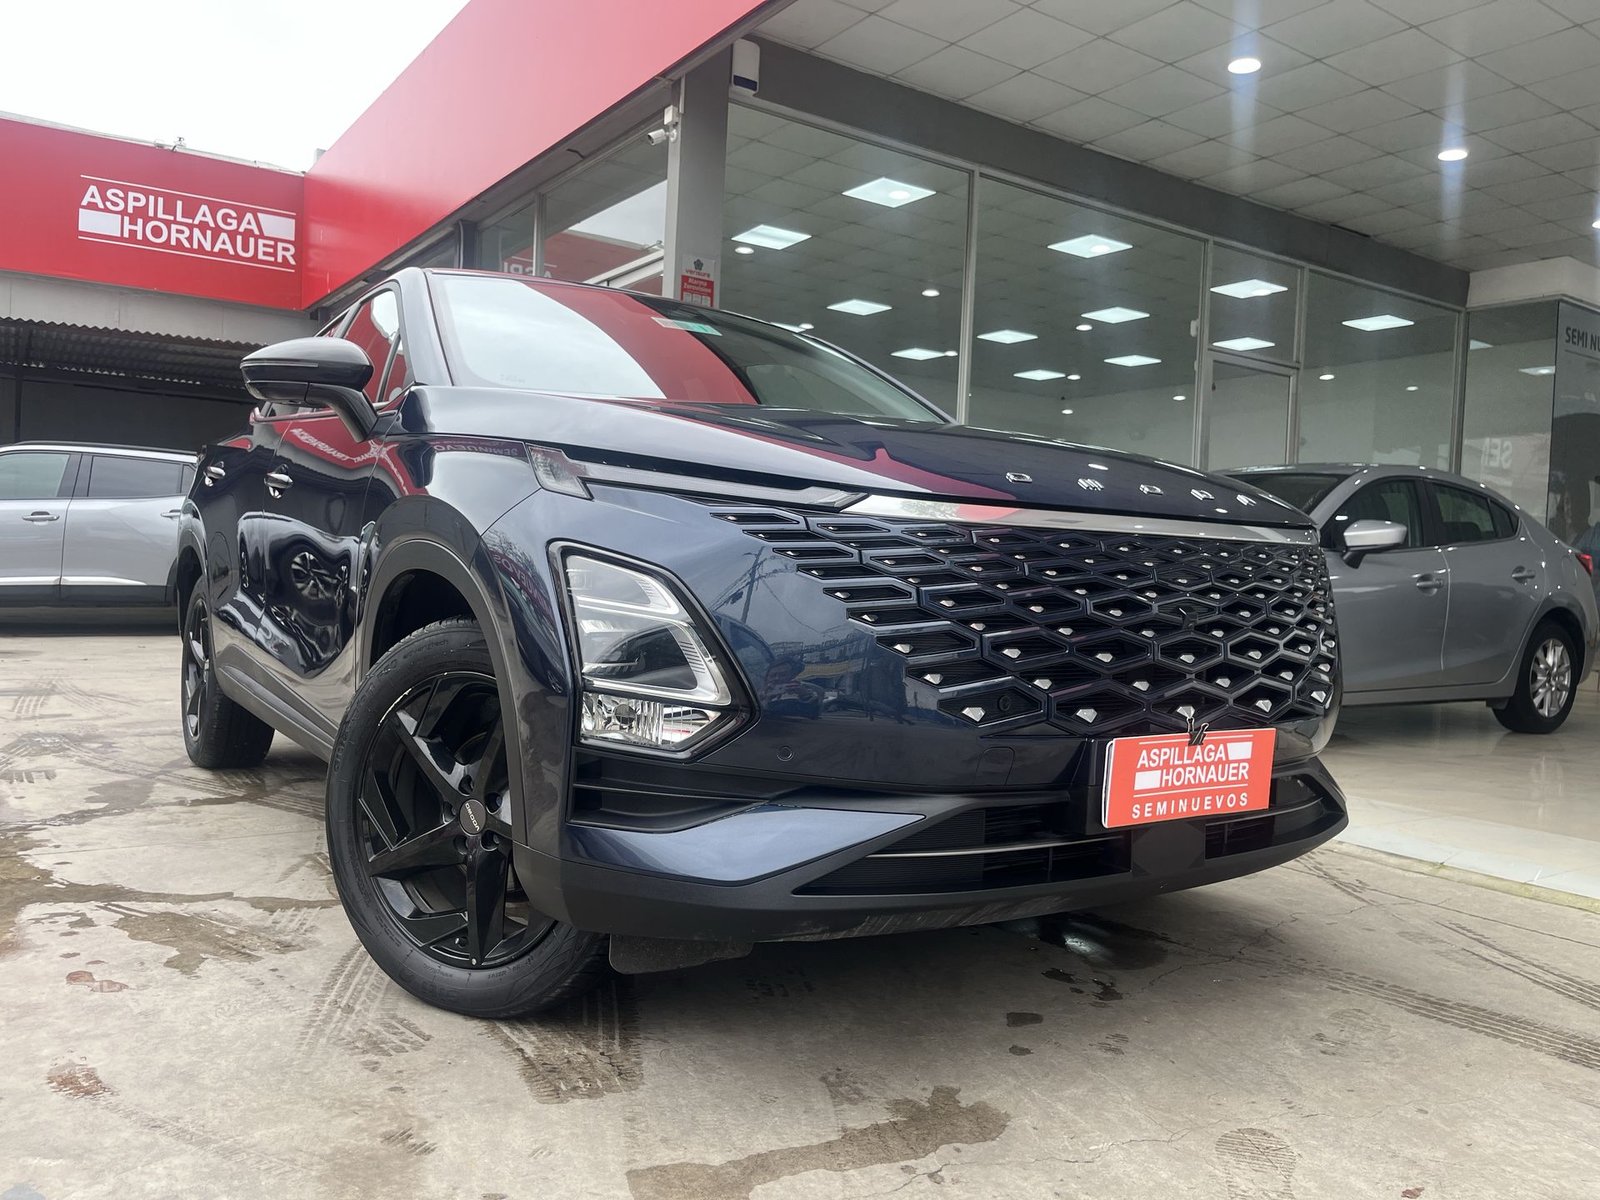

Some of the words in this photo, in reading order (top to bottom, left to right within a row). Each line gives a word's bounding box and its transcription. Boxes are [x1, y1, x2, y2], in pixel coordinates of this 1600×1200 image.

[80, 184, 261, 236] ASPILLAGA
[122, 214, 297, 266] HORNAUER
[1565, 326, 1588, 349] SEMI
[1005, 471, 1257, 507] OMODA
[1137, 743, 1227, 769] ASPILLAGA
[1161, 762, 1249, 788] HORNAUER
[464, 802, 480, 832] OMODA
[1132, 792, 1249, 820] SEMINUEVOS
